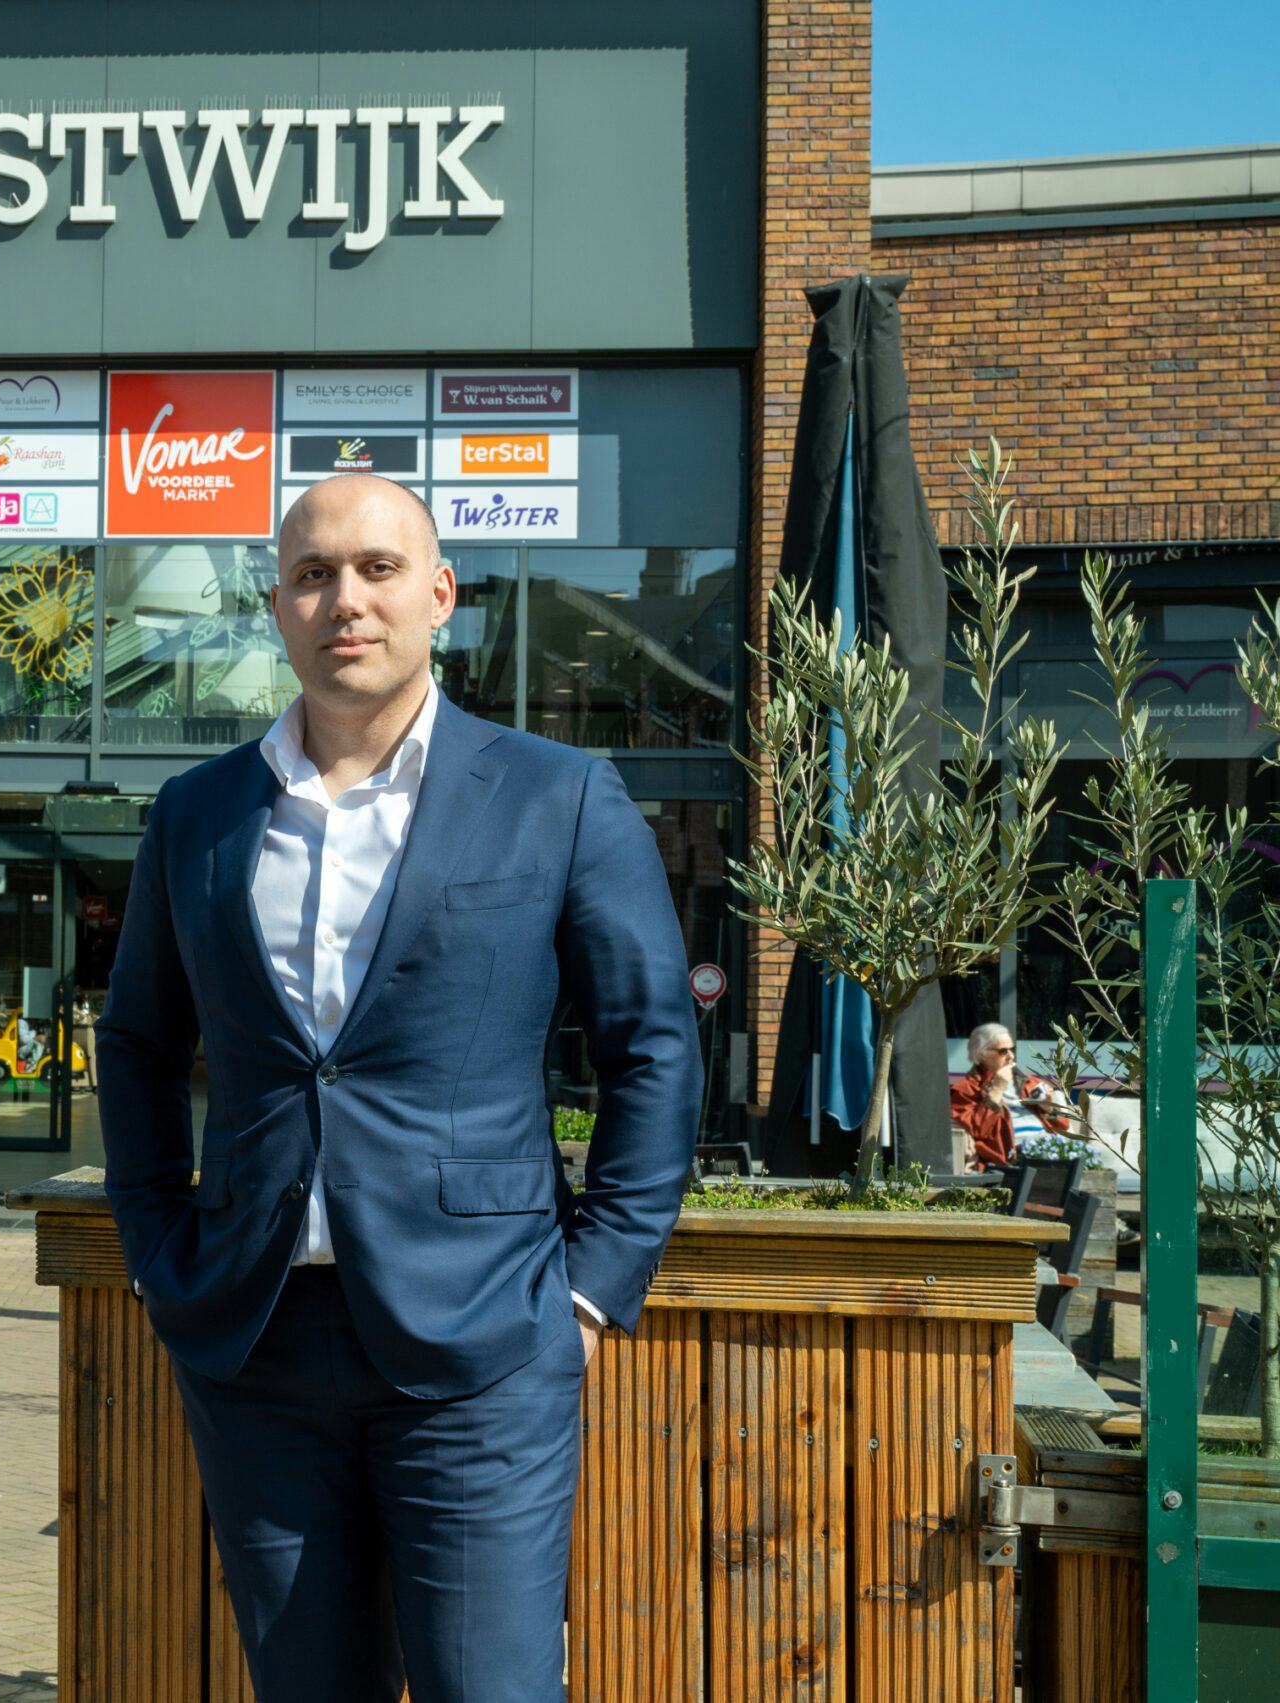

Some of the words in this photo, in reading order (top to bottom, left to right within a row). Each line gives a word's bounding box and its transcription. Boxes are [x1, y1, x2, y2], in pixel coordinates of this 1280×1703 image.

[296, 384, 351, 397] EMILY'S
[356, 384, 414, 397] CHOICE
[464, 384, 548, 394] Slijterij-Wijnhandel
[464, 395, 479, 405] W.
[481, 396, 502, 405] van
[506, 394, 548, 405] Schaik
[464, 442, 545, 463] terStal
[148, 475, 235, 488] VOORDEEL
[163, 489, 219, 501] MARKT
[1173, 704, 1185, 717] &
